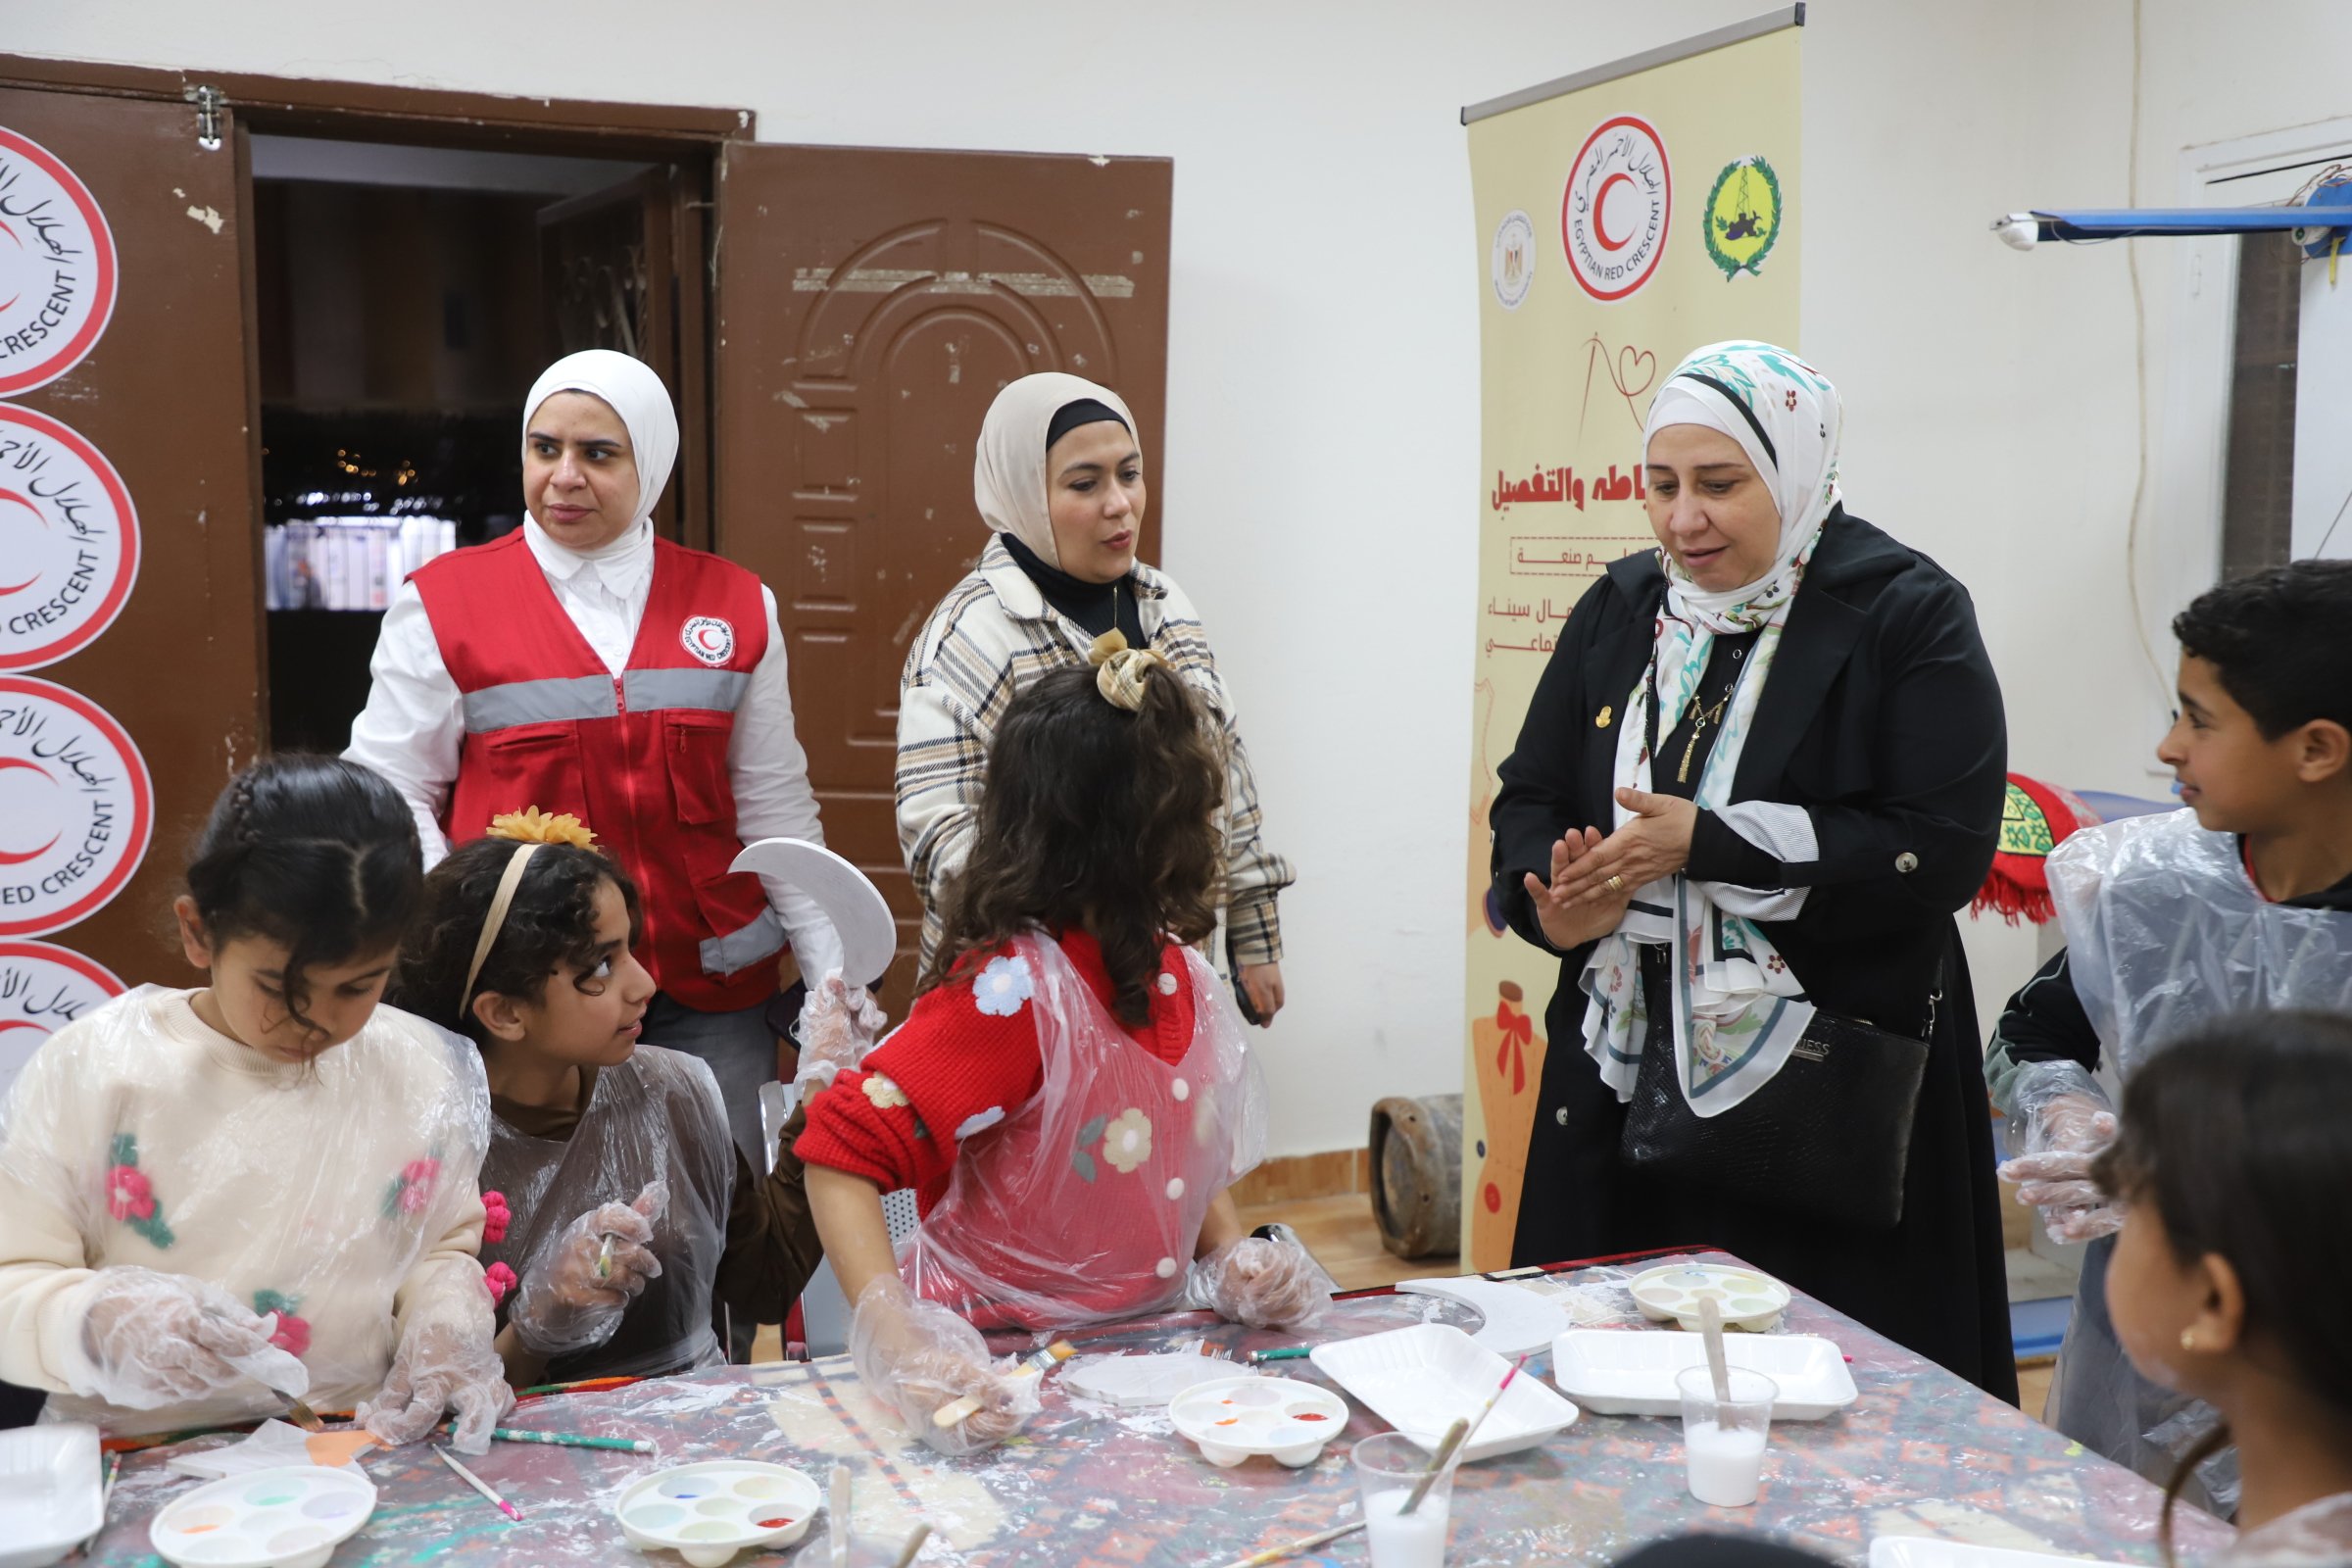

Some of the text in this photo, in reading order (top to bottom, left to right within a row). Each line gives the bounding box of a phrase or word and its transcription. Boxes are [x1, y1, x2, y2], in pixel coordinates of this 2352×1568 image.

[1628, 152, 1661, 195] الهلال
[1574, 219, 1604, 279] EGYPTIAN
[1604, 265, 1625, 280] RED
[1626, 199, 1660, 272] CRESCENT
[28, 476, 108, 545] الهلال
[1493, 464, 1585, 513] والتفصيل
[1517, 547, 1582, 564] صنعة
[9, 549, 99, 635] CRESCENT
[1488, 596, 1530, 622] سيناء
[31, 735, 118, 793] الهلال
[0, 800, 114, 906] ED CRESCENT
[1797, 1038, 1831, 1055] UESS
